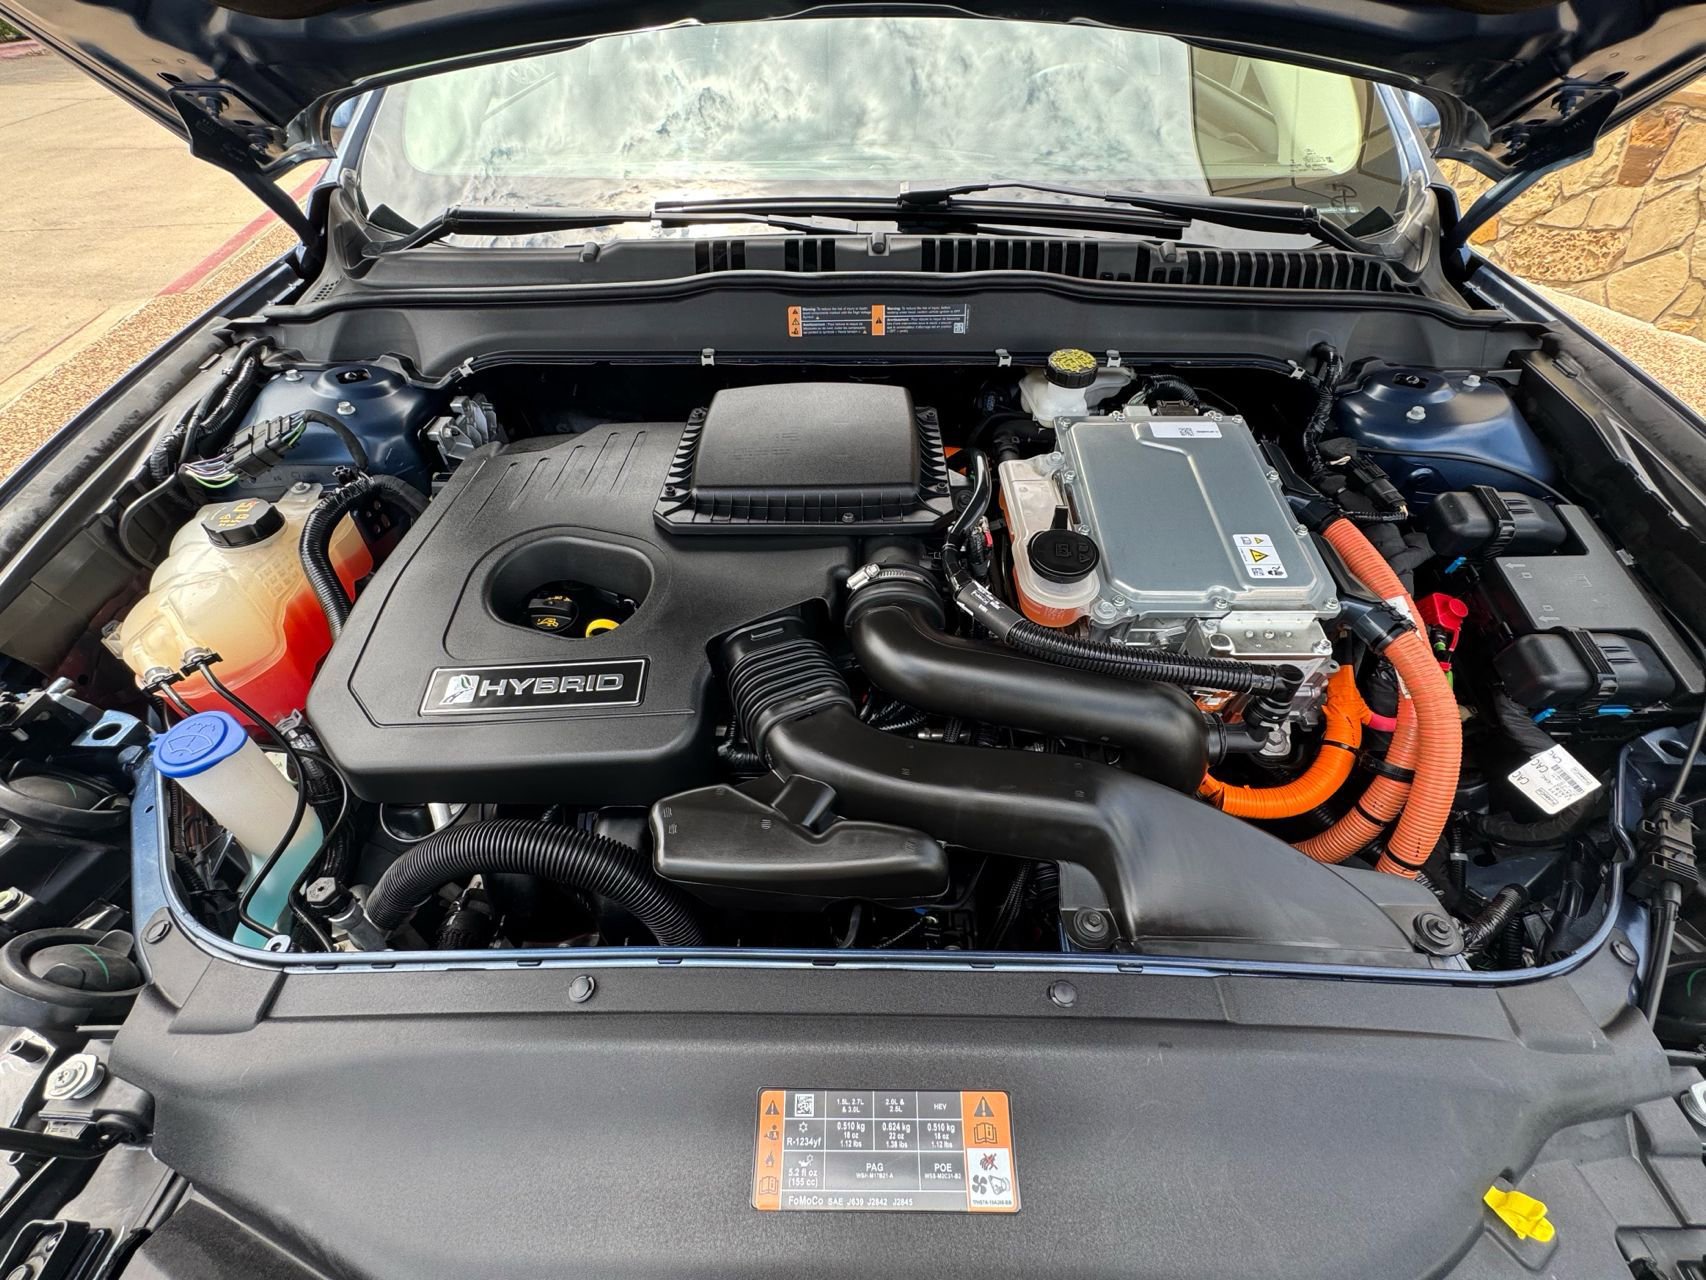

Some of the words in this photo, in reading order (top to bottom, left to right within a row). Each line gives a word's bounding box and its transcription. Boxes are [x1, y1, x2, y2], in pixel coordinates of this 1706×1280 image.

[479, 674, 624, 696] HYBRID
[1530, 759, 1548, 773] CAC
[1512, 771, 1529, 785] CAC
[837, 1122, 855, 1130] 0.510
[856, 1122, 865, 1132] kg
[882, 1122, 900, 1131] 0.624
[902, 1122, 910, 1133] kg
[927, 1123, 944, 1131] 0.510
[946, 1123, 955, 1133] kg
[786, 1137, 821, 1148] R-1234yf
[788, 1168, 799, 1176] 5.2
[801, 1168, 806, 1176] fl
[866, 1163, 884, 1171] PAG
[934, 1163, 952, 1172] POE
[788, 1178, 804, 1188] (155
[806, 1178, 818, 1187] cc)
[788, 1196, 824, 1205] FoMoCo
